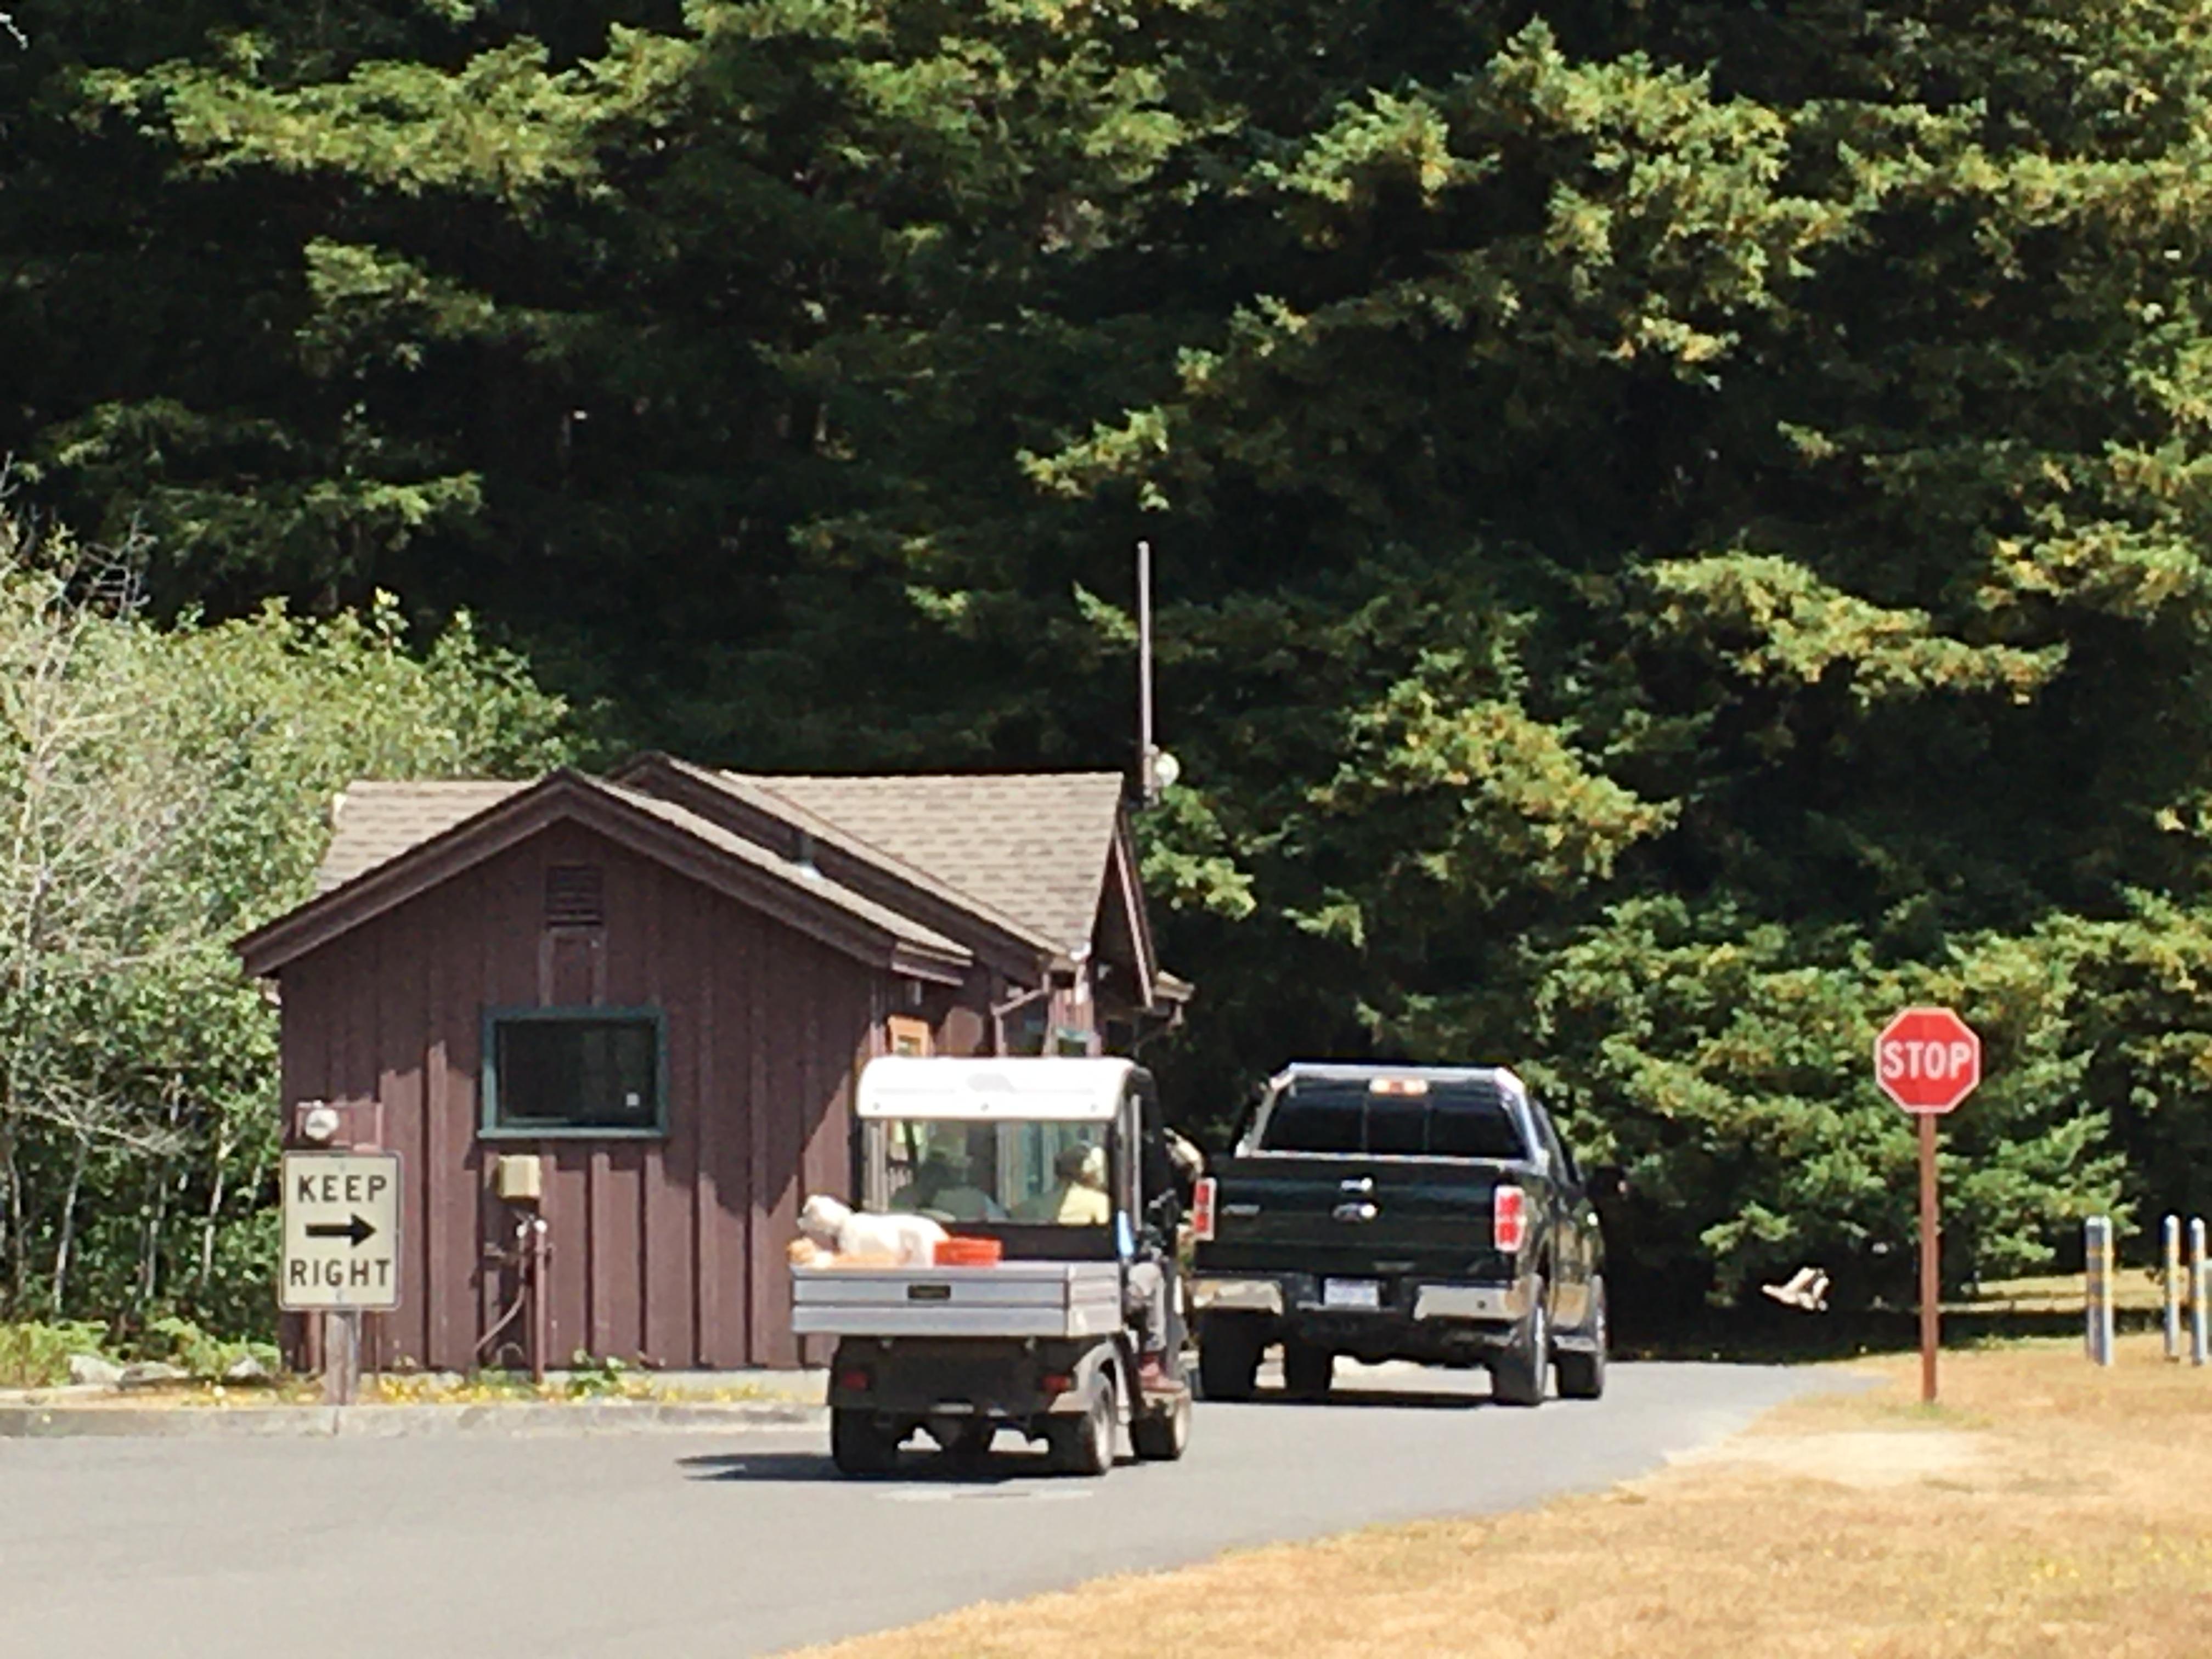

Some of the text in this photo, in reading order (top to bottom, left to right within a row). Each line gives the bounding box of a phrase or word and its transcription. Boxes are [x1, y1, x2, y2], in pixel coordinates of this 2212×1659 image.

[1883, 1040, 1971, 1080] STOP
[298, 1175, 387, 1202] KEEP
[290, 1260, 391, 1286] RIGHT
